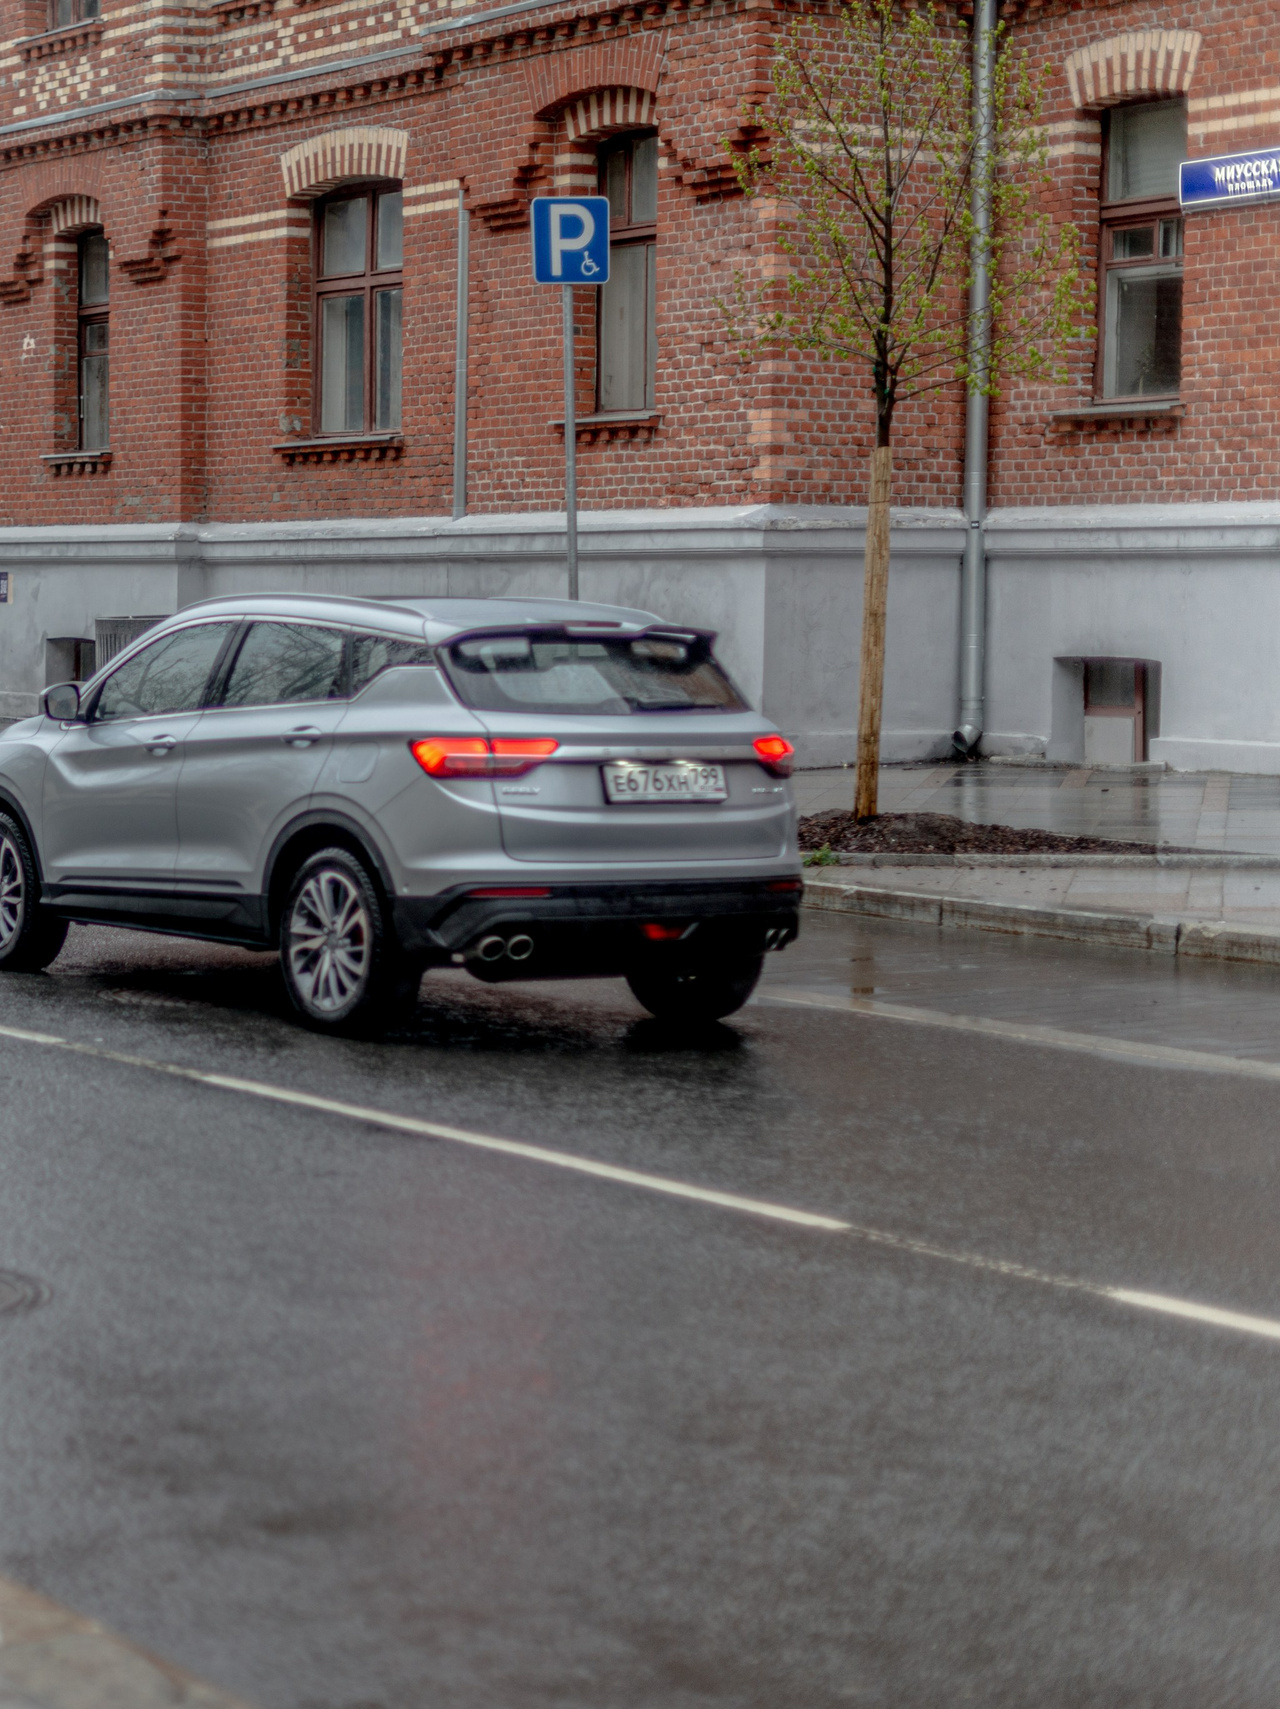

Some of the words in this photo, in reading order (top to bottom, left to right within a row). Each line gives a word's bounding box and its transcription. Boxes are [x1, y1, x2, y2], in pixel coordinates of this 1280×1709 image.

[1214, 159, 1280, 181] МИУССКА
[1228, 178, 1273, 191] ПЛОЩАДЬ
[550, 204, 595, 276] P
